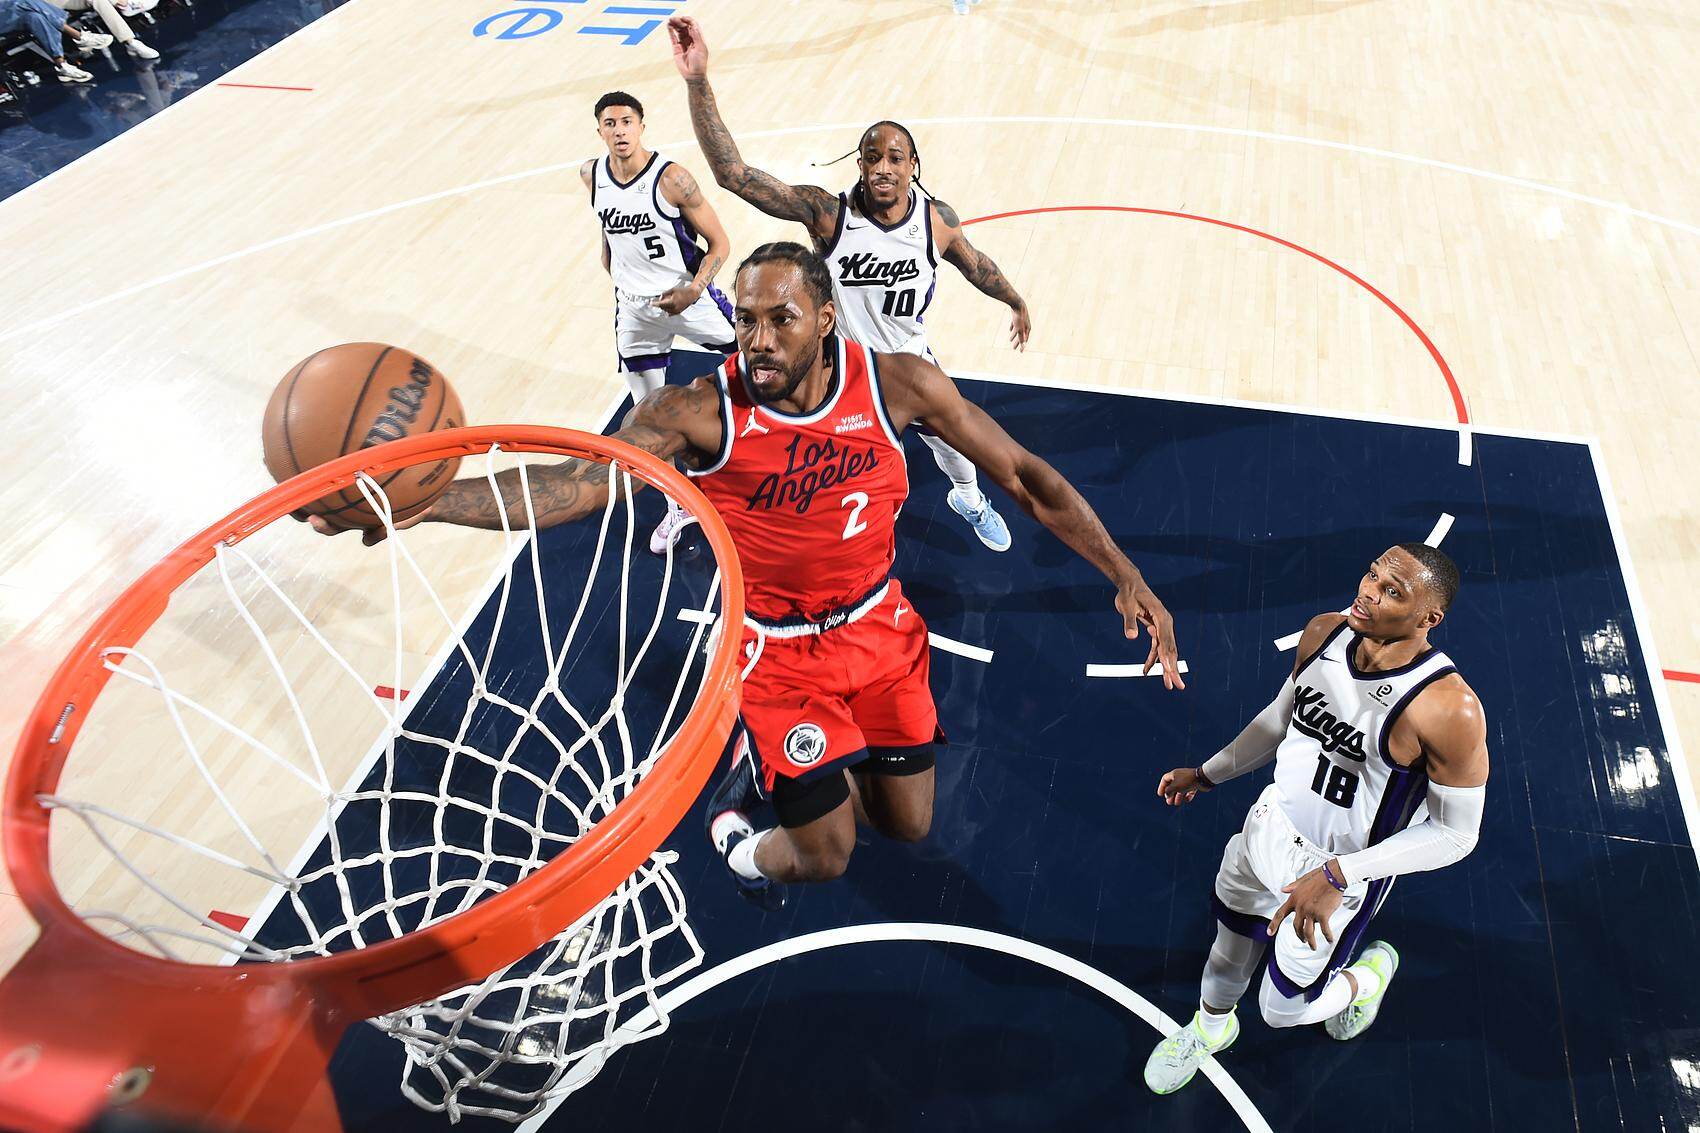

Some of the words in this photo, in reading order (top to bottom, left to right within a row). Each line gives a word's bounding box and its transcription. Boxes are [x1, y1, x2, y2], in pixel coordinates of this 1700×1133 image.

[598, 207, 656, 235] Kings
[644, 235, 666, 260] 5
[838, 253, 919, 287] Kings
[882, 288, 916, 317] 10
[834, 419, 873, 434] RWANDA
[841, 413, 863, 425] VISIT
[785, 433, 839, 477] Los
[745, 445, 879, 514] Angeles
[841, 491, 869, 541] 2
[1293, 685, 1366, 762] Kings
[1310, 752, 1360, 809] 18
